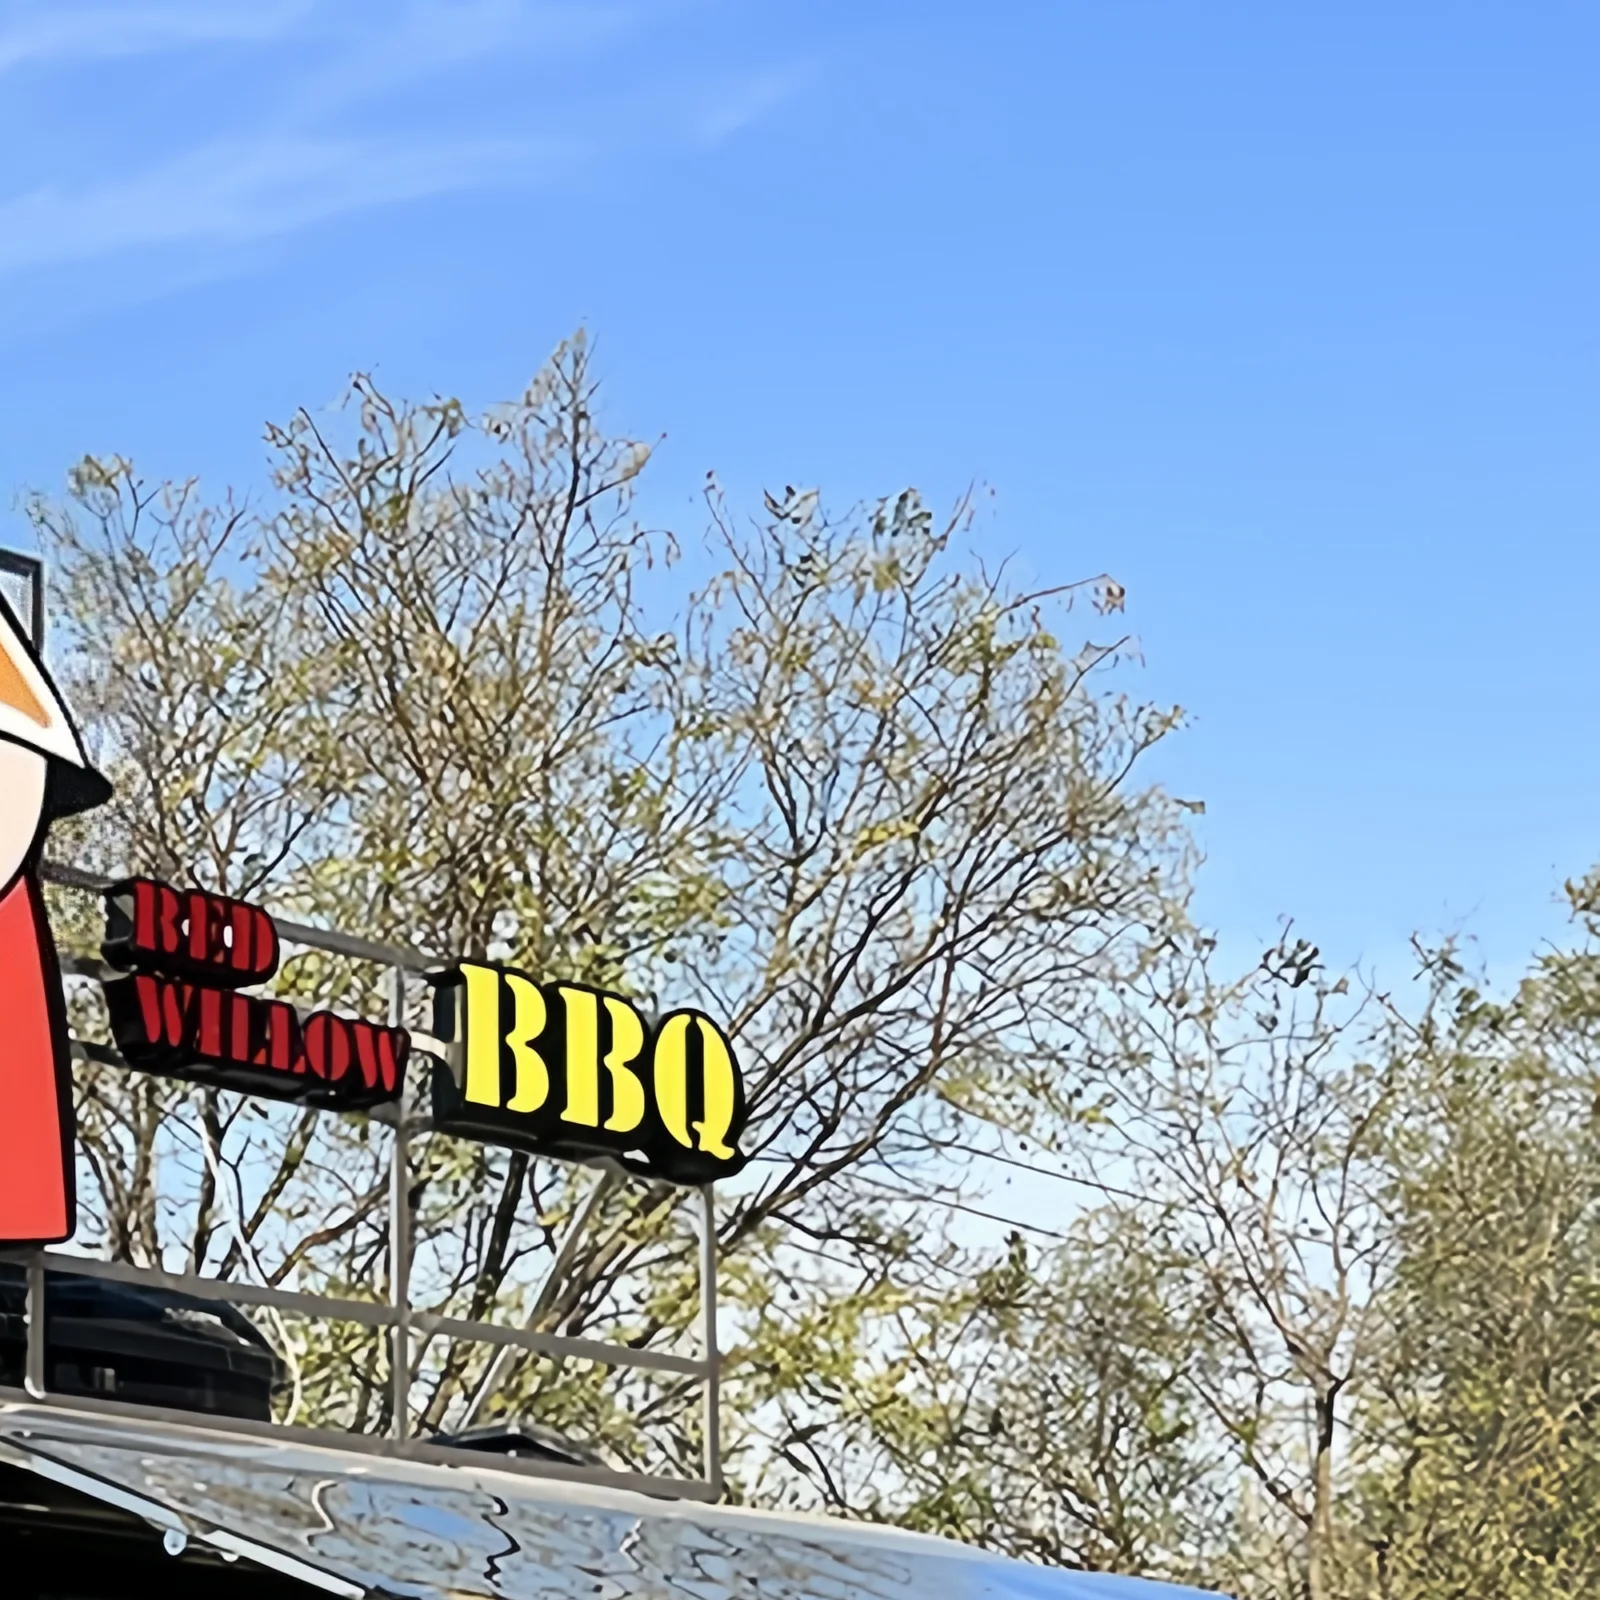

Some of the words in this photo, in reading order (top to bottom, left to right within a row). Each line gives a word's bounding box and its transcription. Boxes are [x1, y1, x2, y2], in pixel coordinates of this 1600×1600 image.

[134, 881, 275, 973] RED
[135, 975, 403, 1092] WILLOW
[459, 963, 736, 1160] BBQ
